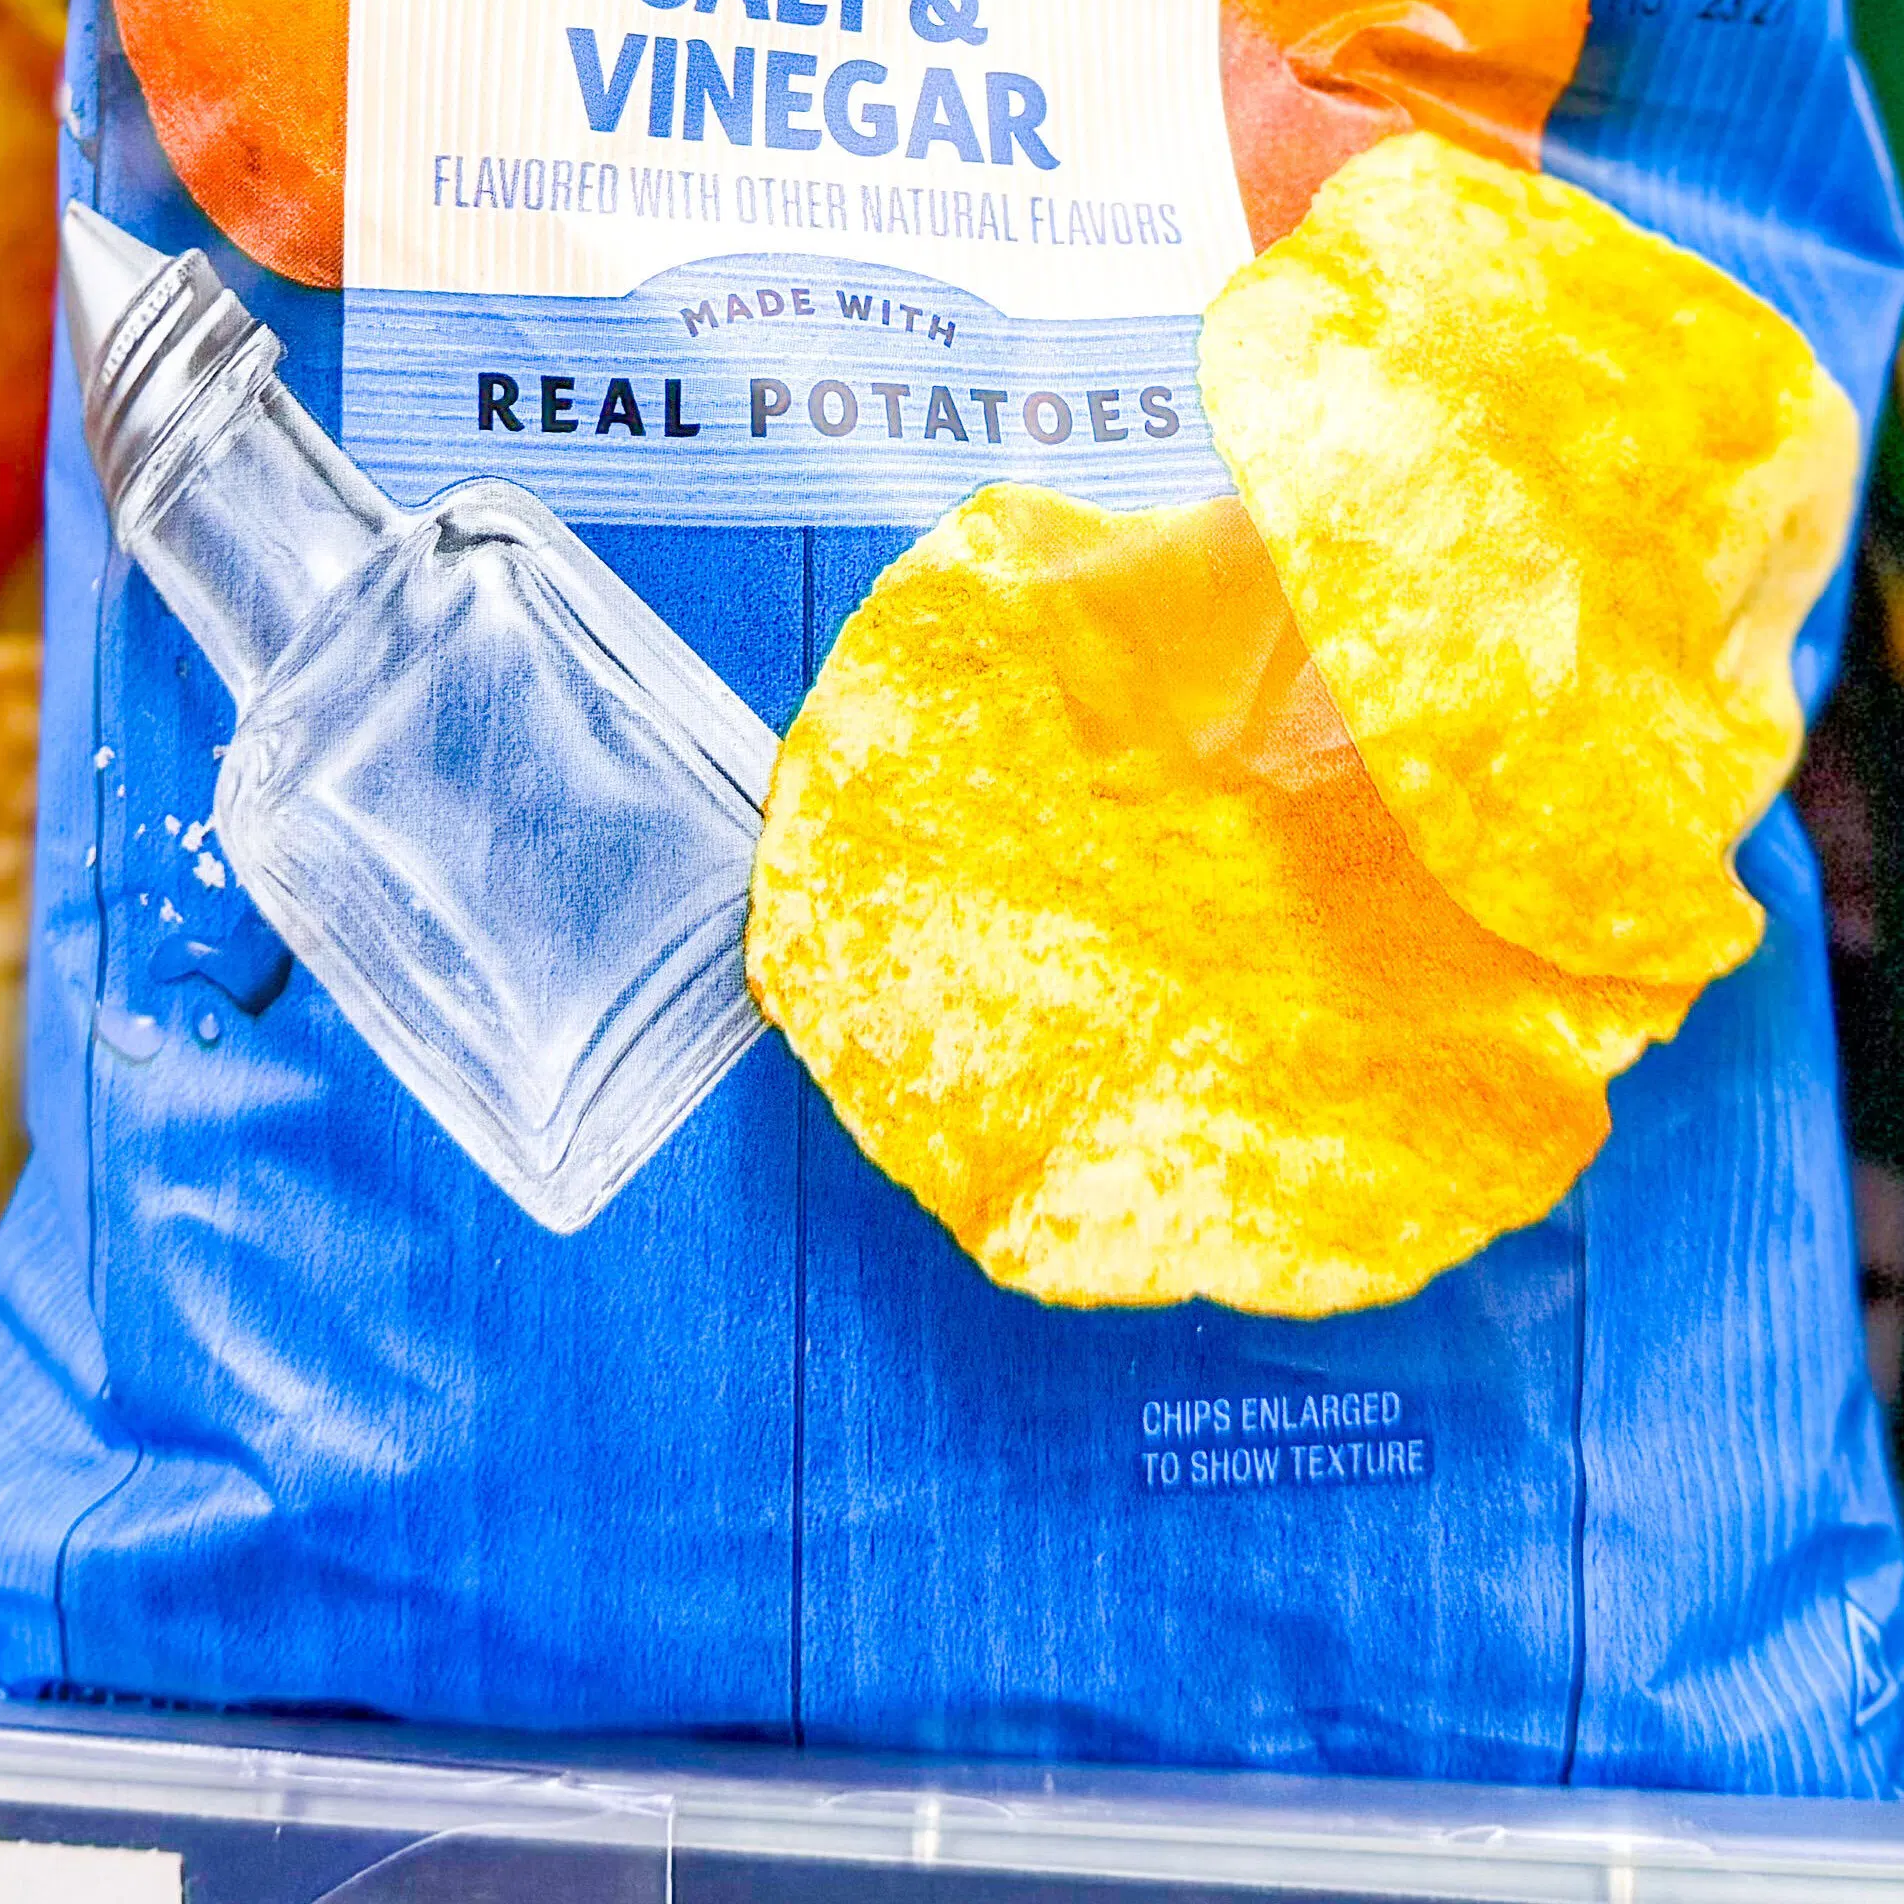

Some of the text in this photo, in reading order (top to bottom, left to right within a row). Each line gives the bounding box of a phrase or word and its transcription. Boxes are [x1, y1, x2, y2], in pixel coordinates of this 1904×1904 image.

[566, 27, 1061, 170] VINEGAR
[433, 155, 1183, 246] FLAVORED WITH OTHER NATURAL FLAVORS
[680, 288, 956, 348] MADE WITH
[477, 372, 1181, 445] REAL POTATOES
[1142, 1391, 1400, 1438] CHIPS ENLARGED
[1142, 1439, 1424, 1486] TO SHOW TEXTURE
